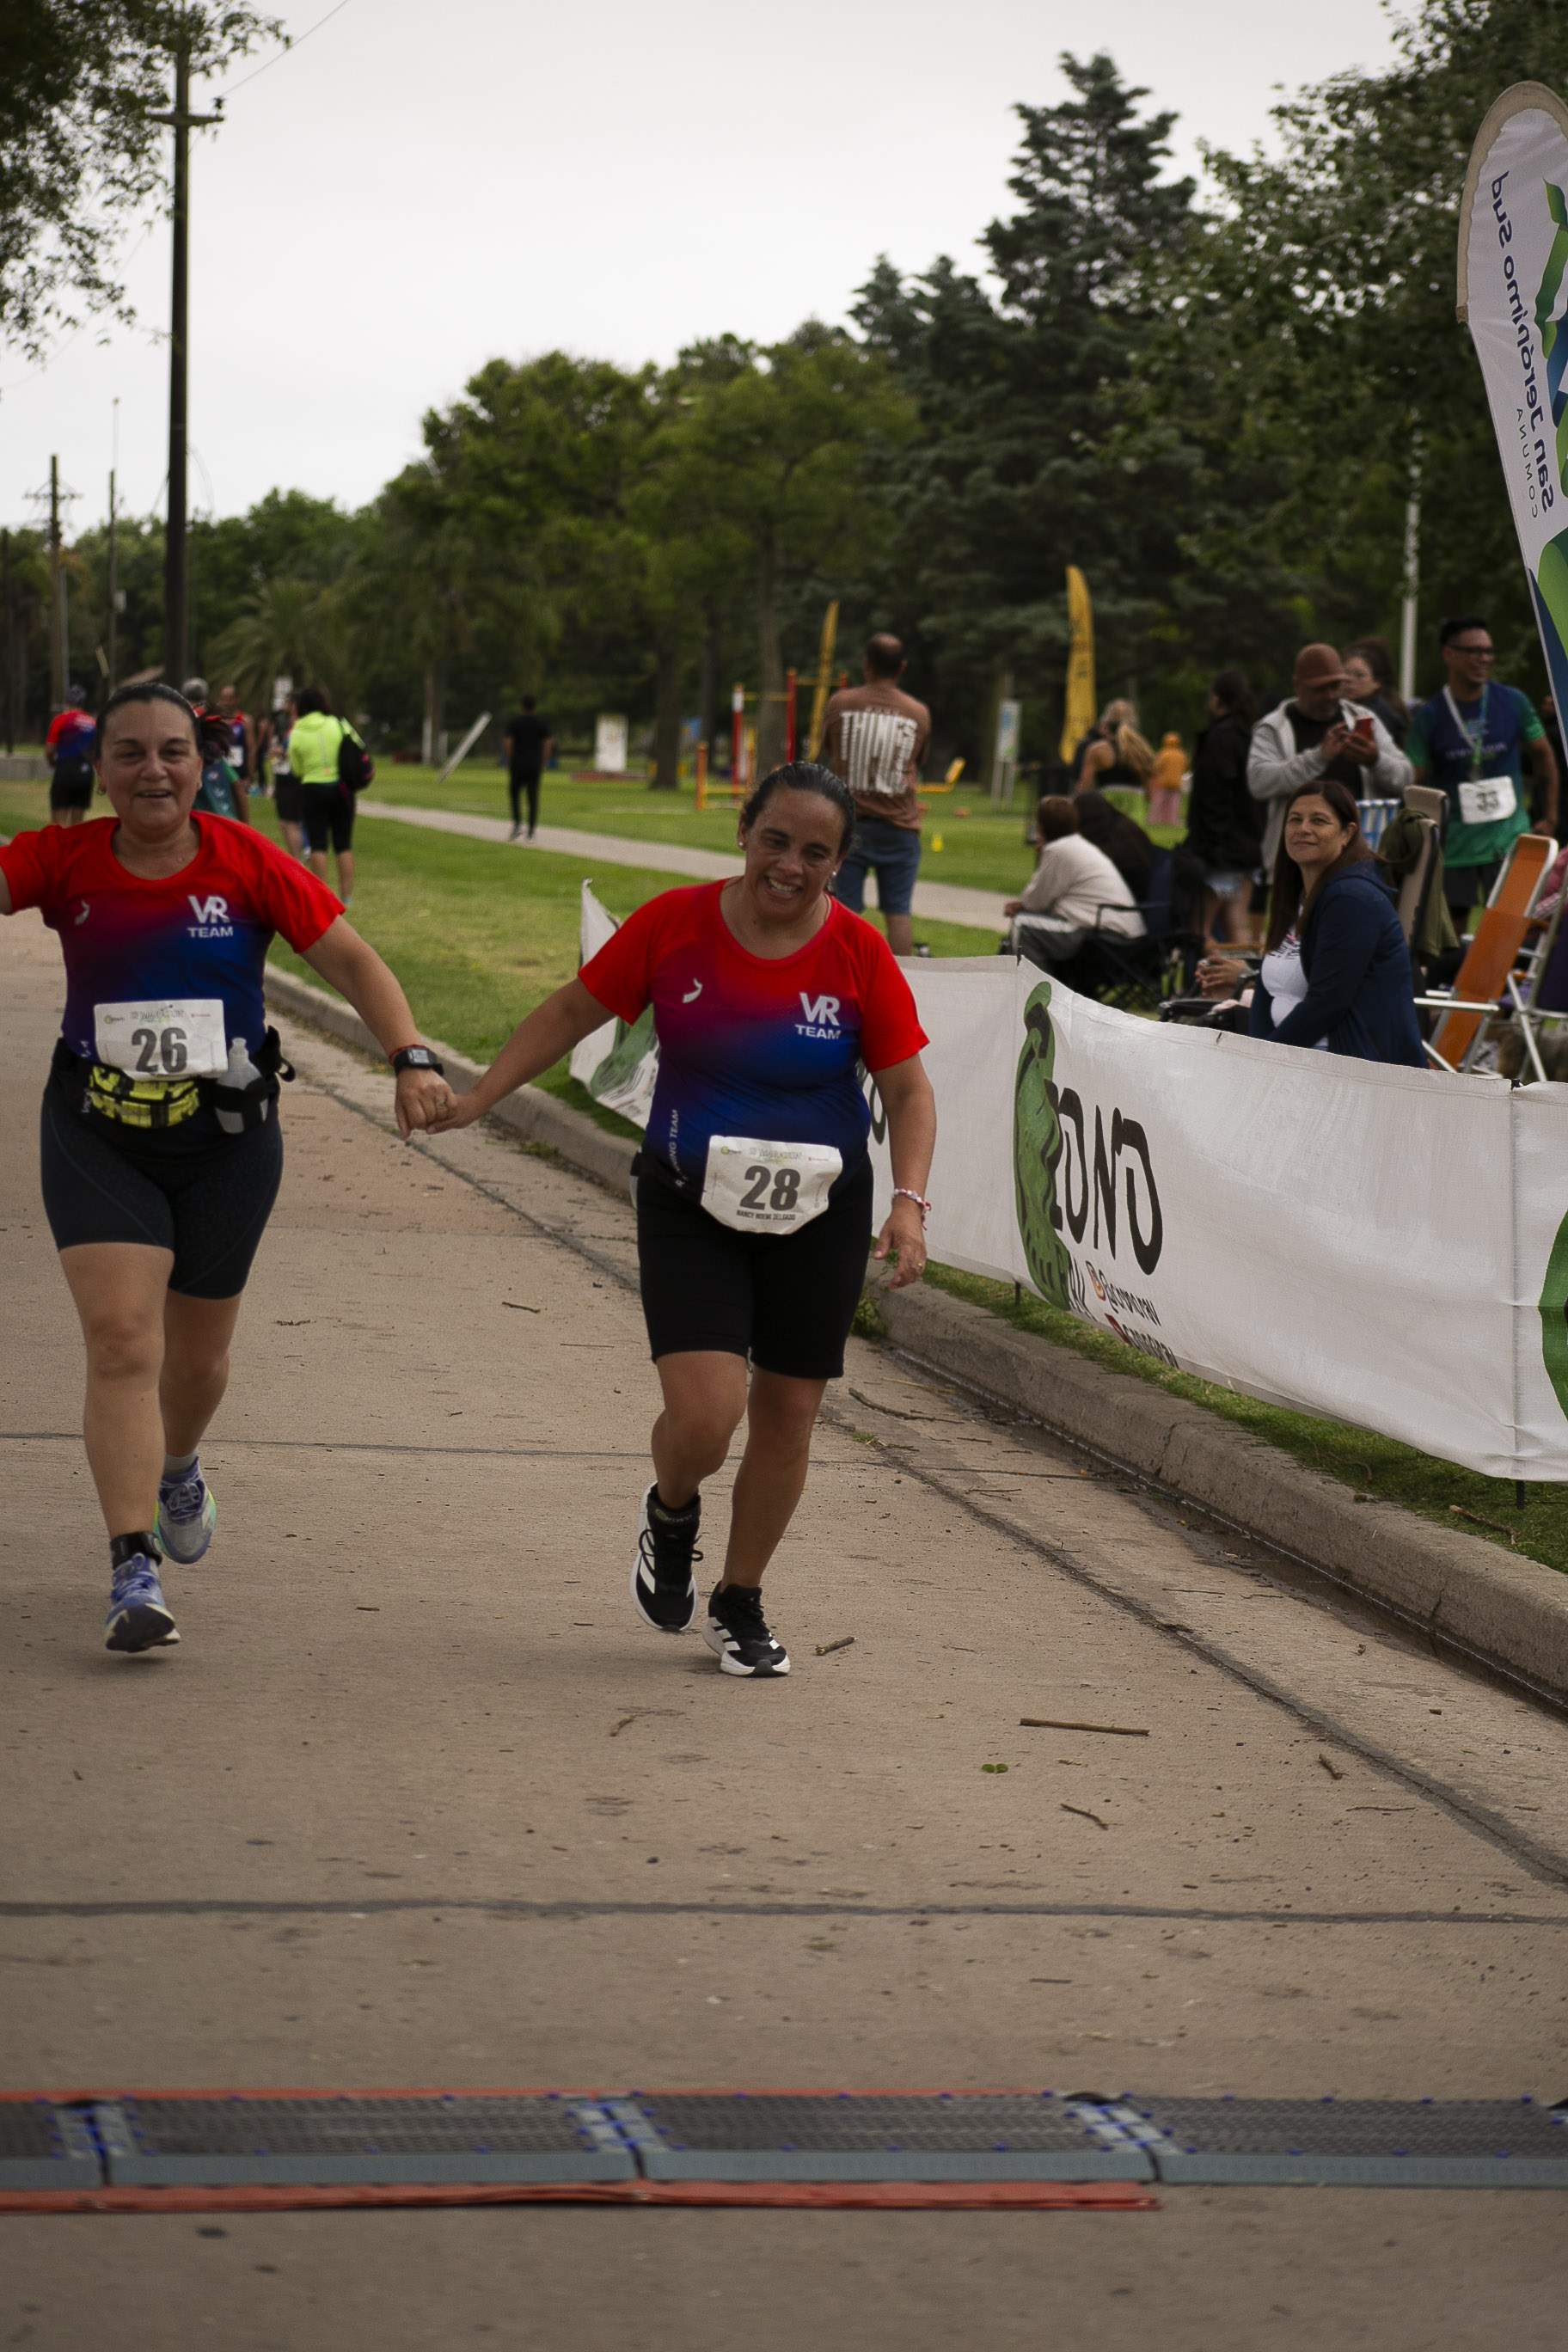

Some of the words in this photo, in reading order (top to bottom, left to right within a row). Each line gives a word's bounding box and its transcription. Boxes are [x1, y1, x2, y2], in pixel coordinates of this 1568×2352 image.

[187, 895, 230, 923] VR
[187, 926, 233, 938] TEAM
[799, 991, 840, 1026] VR
[794, 1024, 842, 1040] TEAM
[132, 1027, 187, 1074] 26
[739, 1165, 801, 1211] 28
[736, 1210, 755, 1219] NANCY
